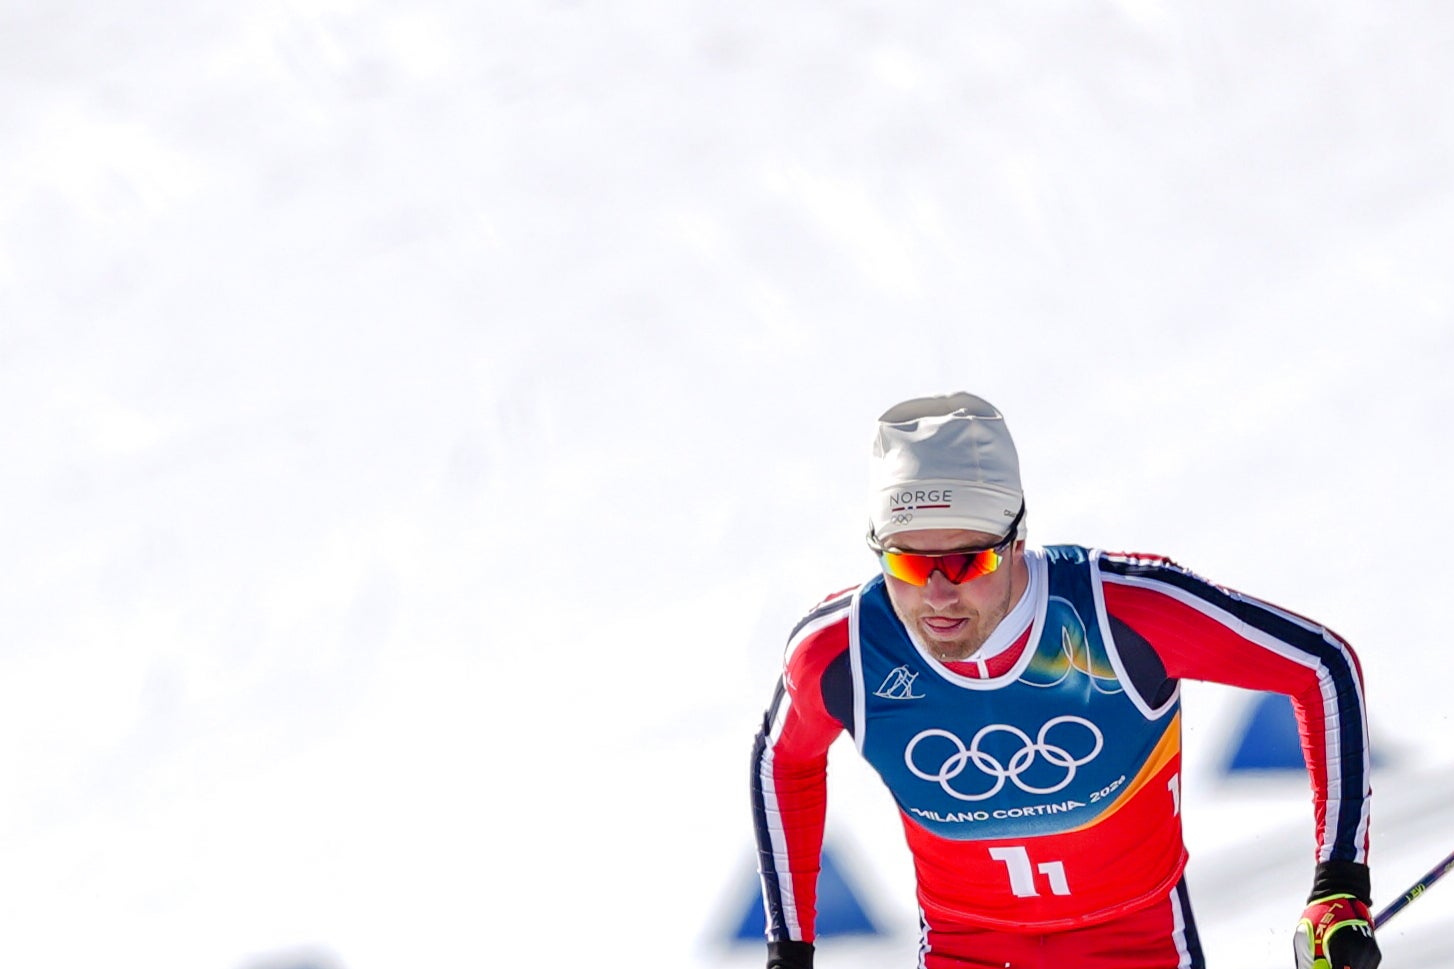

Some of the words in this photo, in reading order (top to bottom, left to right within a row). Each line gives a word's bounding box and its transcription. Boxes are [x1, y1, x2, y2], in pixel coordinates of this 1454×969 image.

[889, 490, 952, 505] NORGE
[910, 807, 989, 823] MILANO
[992, 799, 1086, 820] CORTINA
[1089, 775, 1127, 804] 2026
[1167, 772, 1181, 818] 1
[1313, 902, 1344, 945] LEKI
